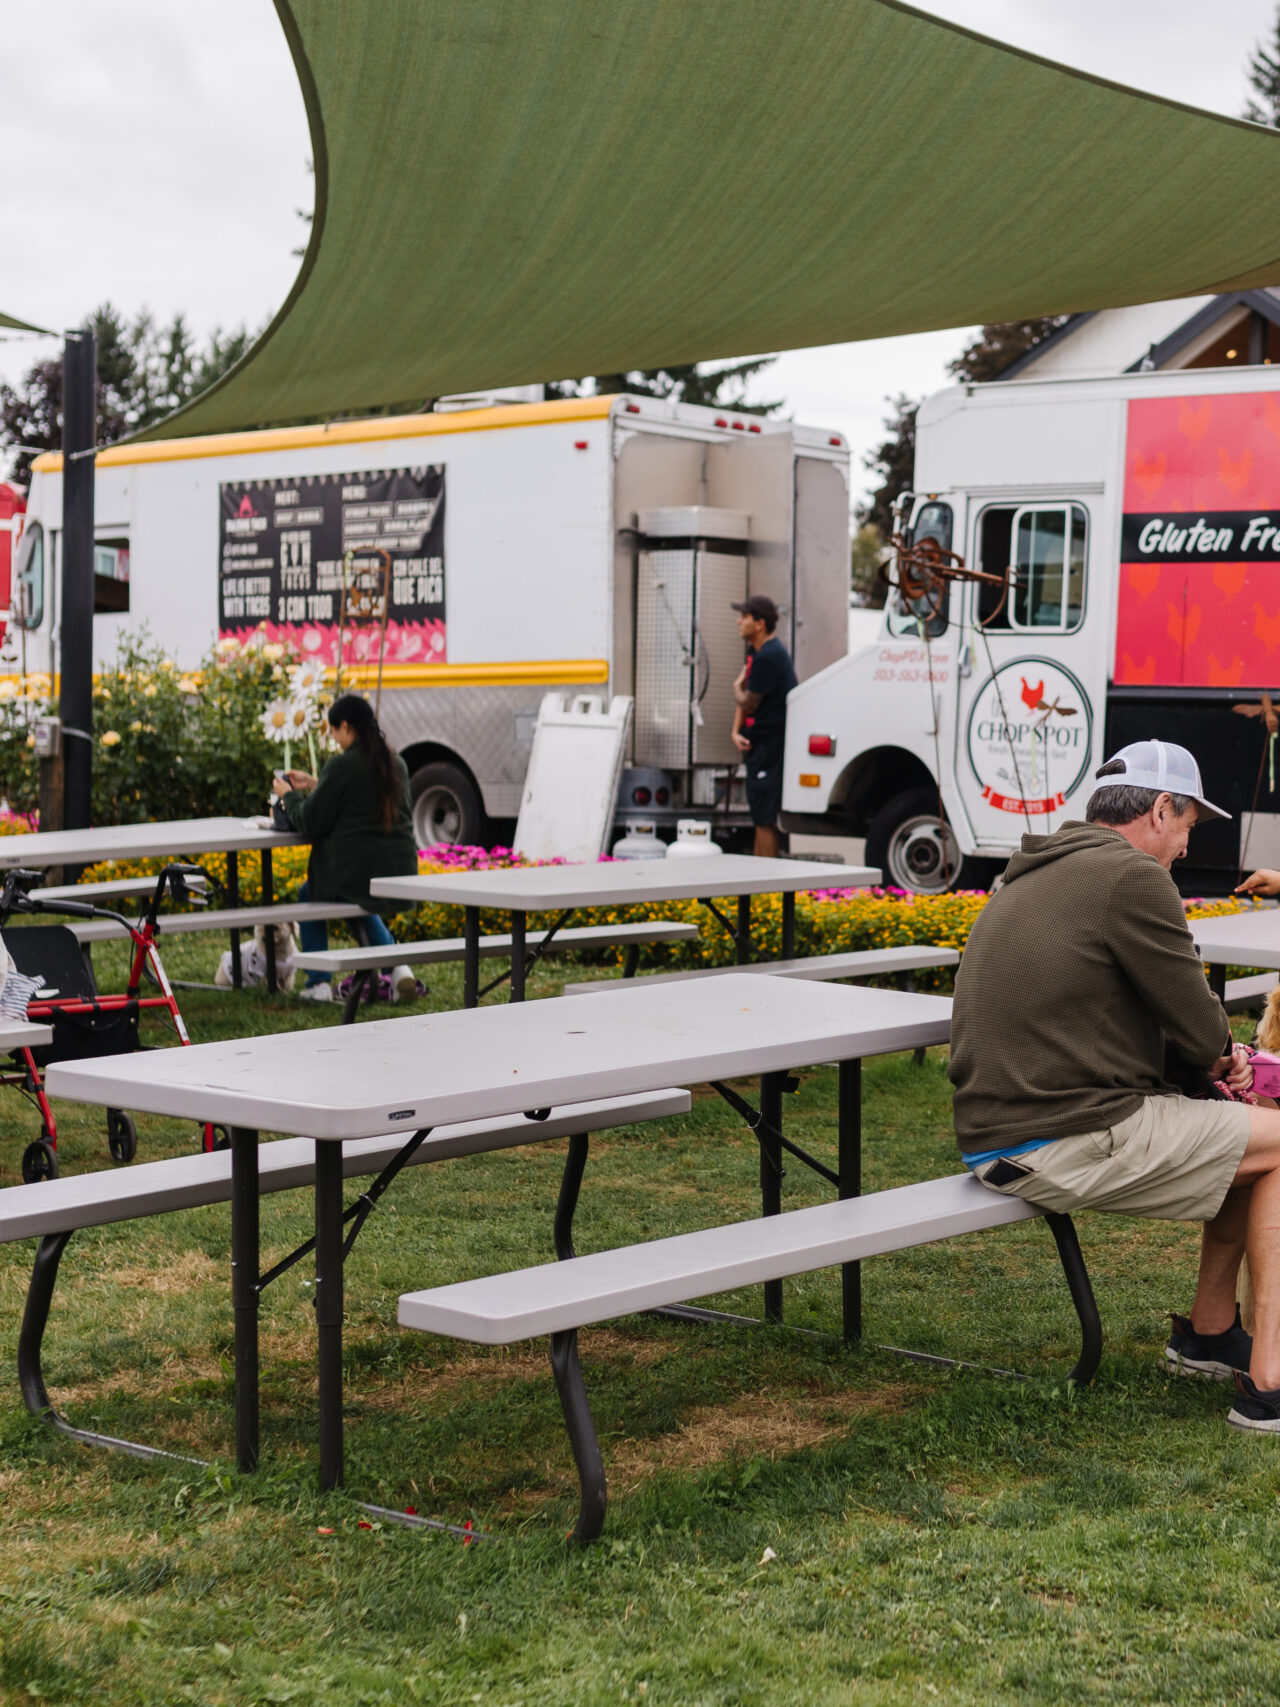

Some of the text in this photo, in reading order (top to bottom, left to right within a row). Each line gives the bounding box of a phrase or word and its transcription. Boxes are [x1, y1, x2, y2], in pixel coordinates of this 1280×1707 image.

[1138, 519, 1234, 553] Gluten
[393, 577, 415, 606] QUE
[417, 575, 443, 605] PICA
[223, 597, 244, 618] WITH
[287, 596, 306, 621] CON
[307, 594, 333, 620] TODO
[977, 721, 1082, 747] CHOP SPOT
